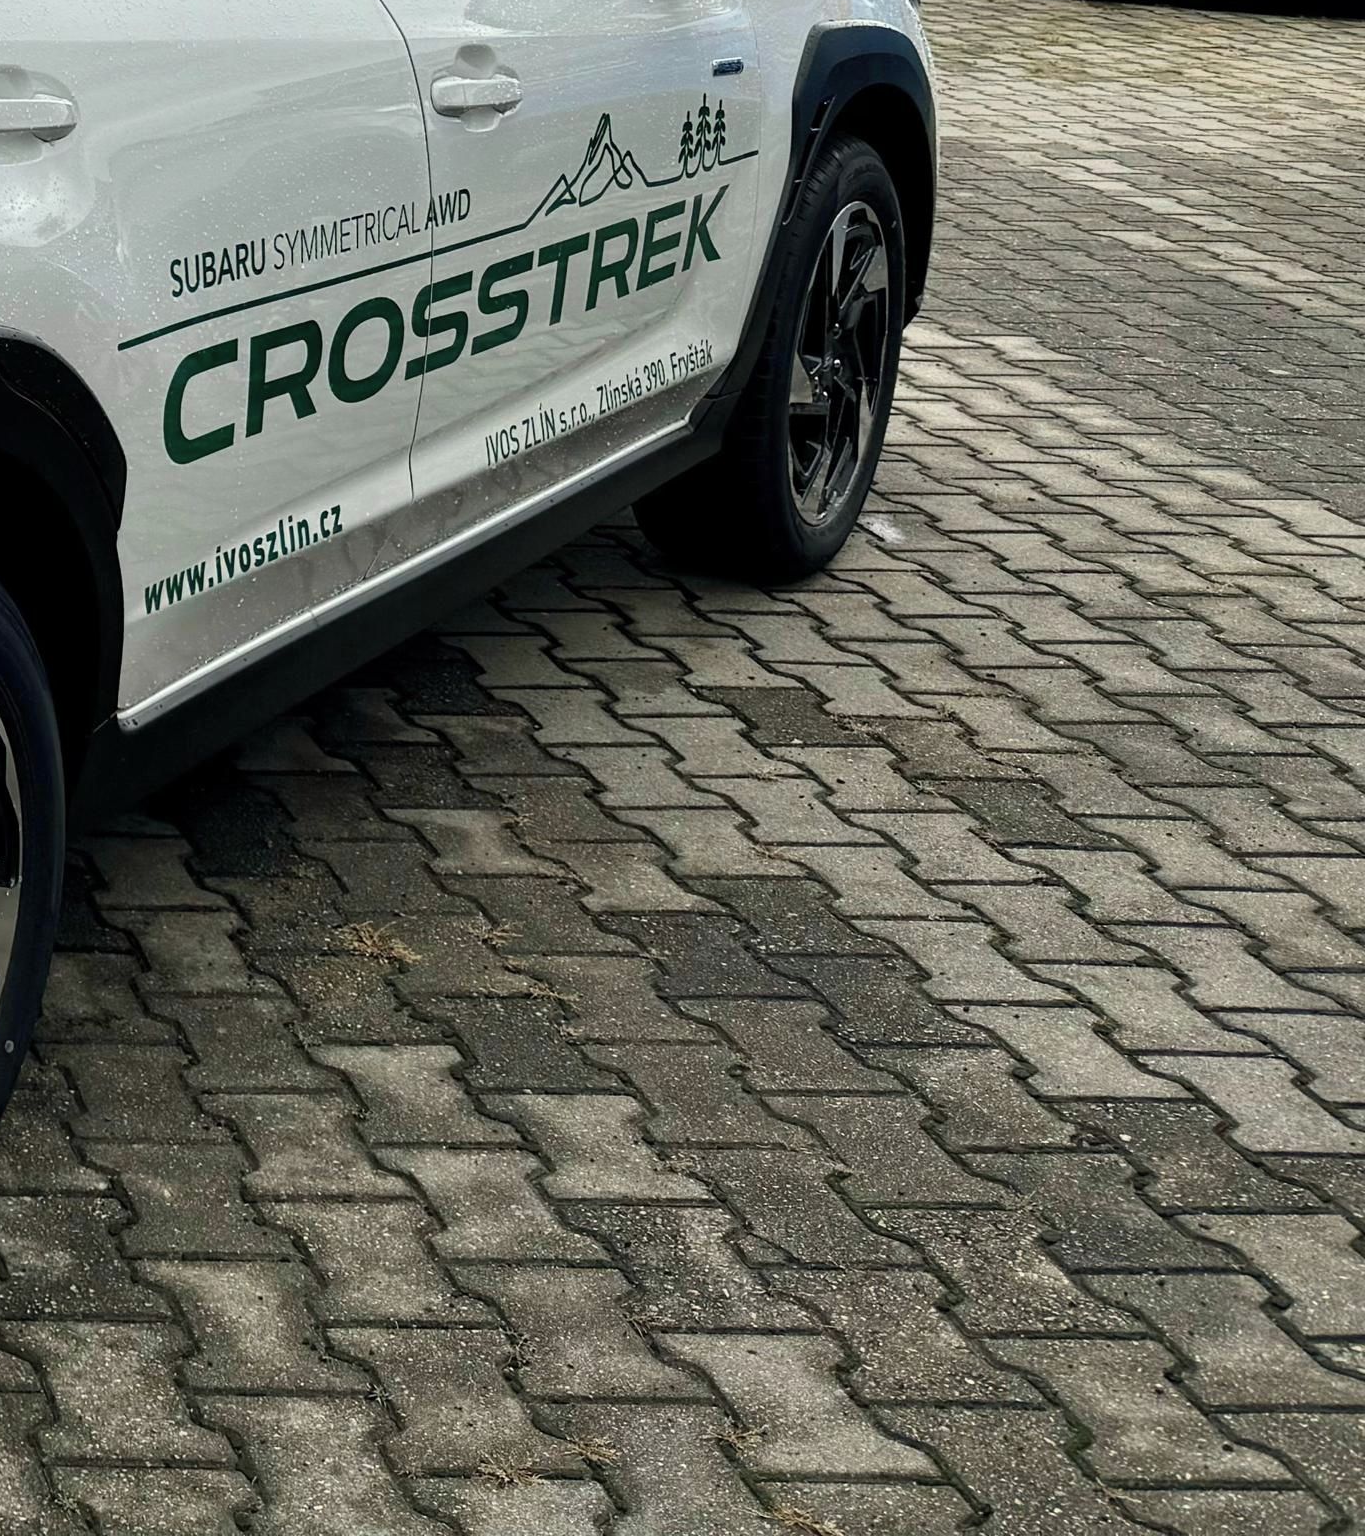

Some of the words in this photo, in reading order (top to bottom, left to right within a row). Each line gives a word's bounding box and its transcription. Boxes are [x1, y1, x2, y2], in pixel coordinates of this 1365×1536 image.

[169, 238, 266, 298] SUBARU
[273, 201, 421, 270] SYMMETRICAL
[424, 188, 471, 231] AWD
[163, 184, 730, 465] CROSSTREK
[485, 424, 519, 467] IVOS
[522, 402, 557, 450] ZLÍN
[596, 367, 643, 416] Zlínská
[643, 358, 669, 393] 390,
[669, 339, 713, 384] Fryšták
[144, 504, 343, 615] www.ivoszlin.cz
